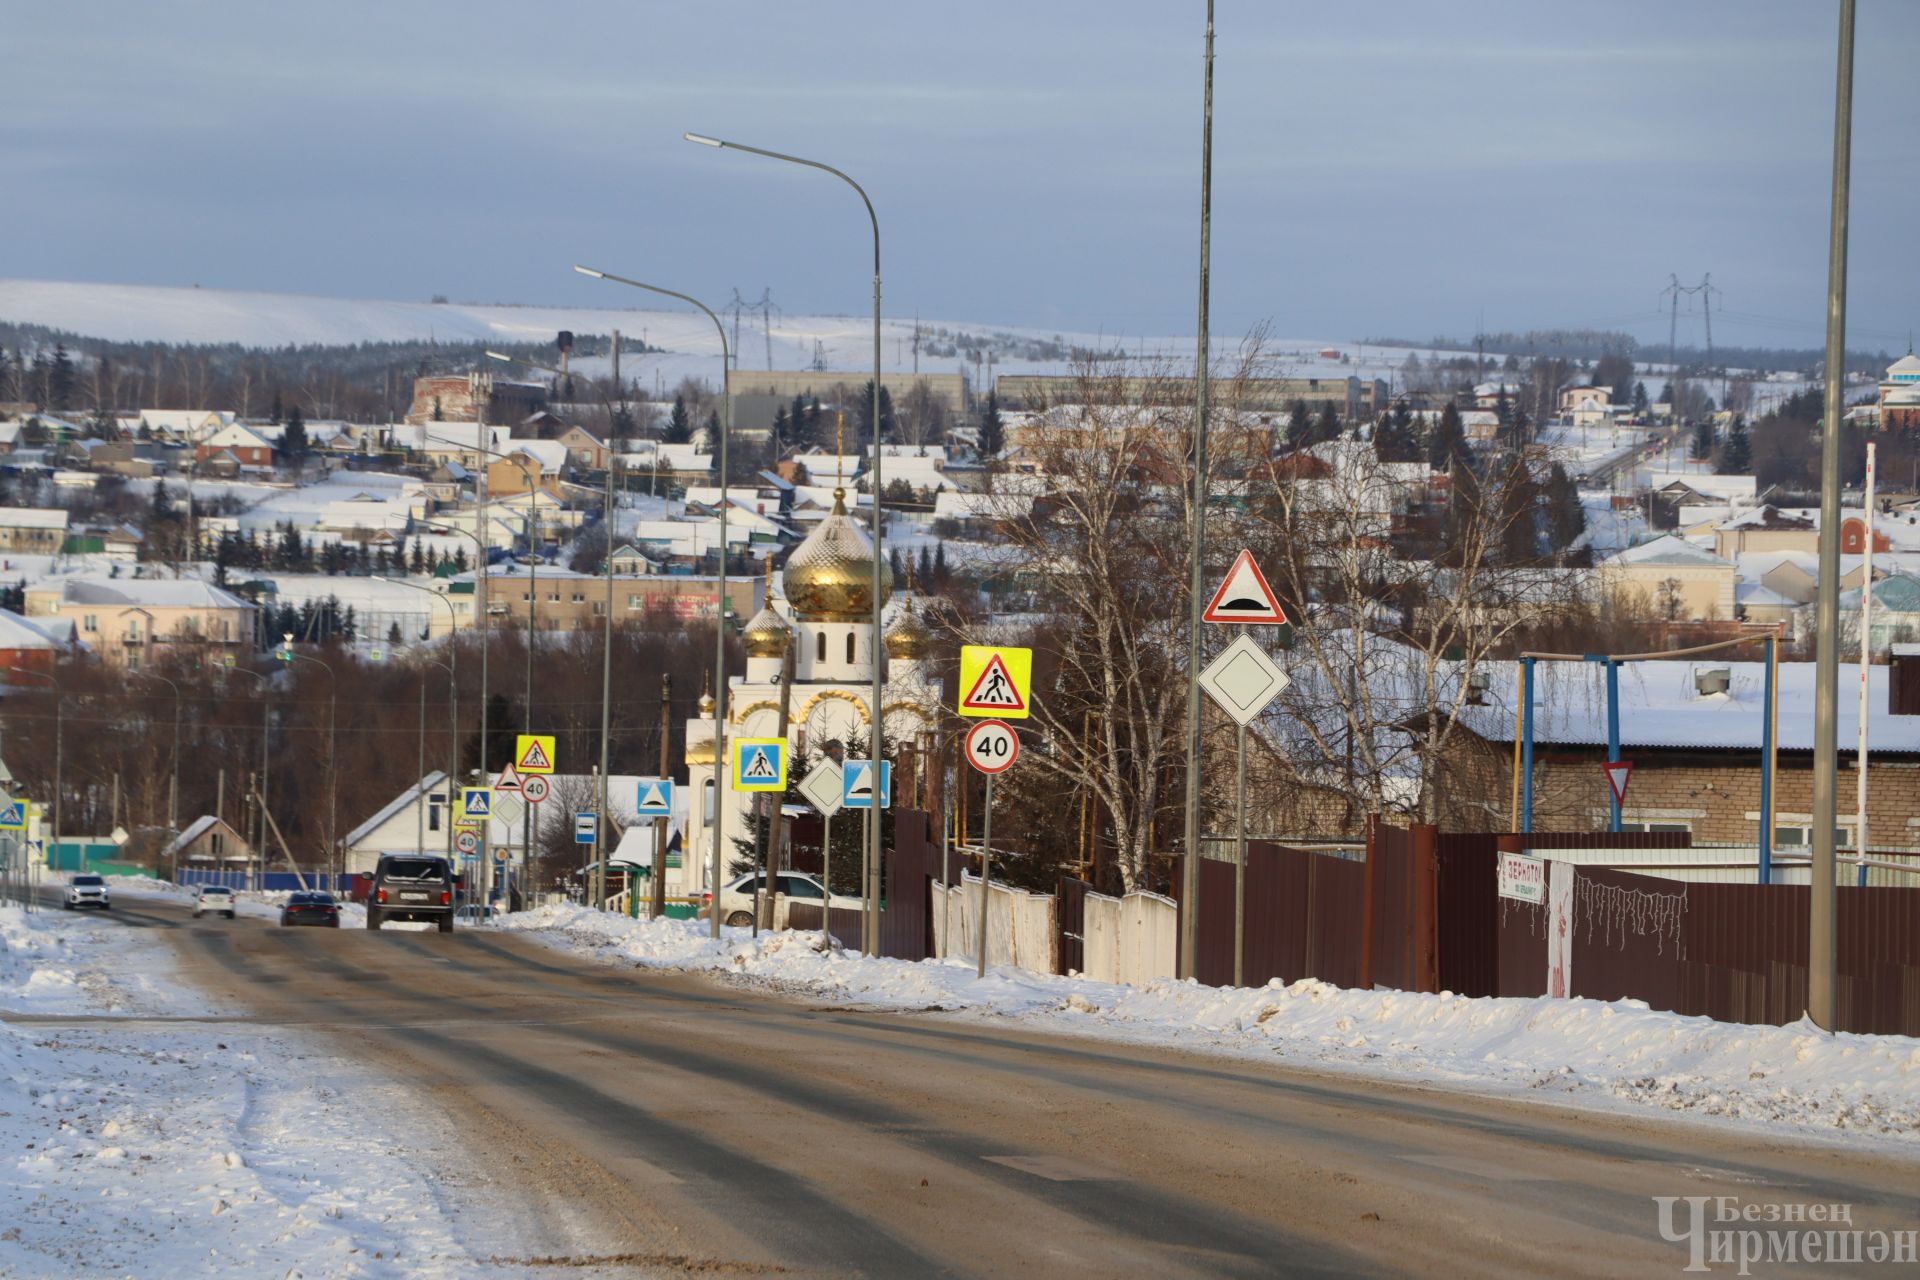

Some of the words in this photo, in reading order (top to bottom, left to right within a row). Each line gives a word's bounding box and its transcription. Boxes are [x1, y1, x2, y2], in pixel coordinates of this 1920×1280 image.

[976, 736, 1008, 757] 40
[526, 783, 543, 795] 40
[460, 837, 474, 847] 40
